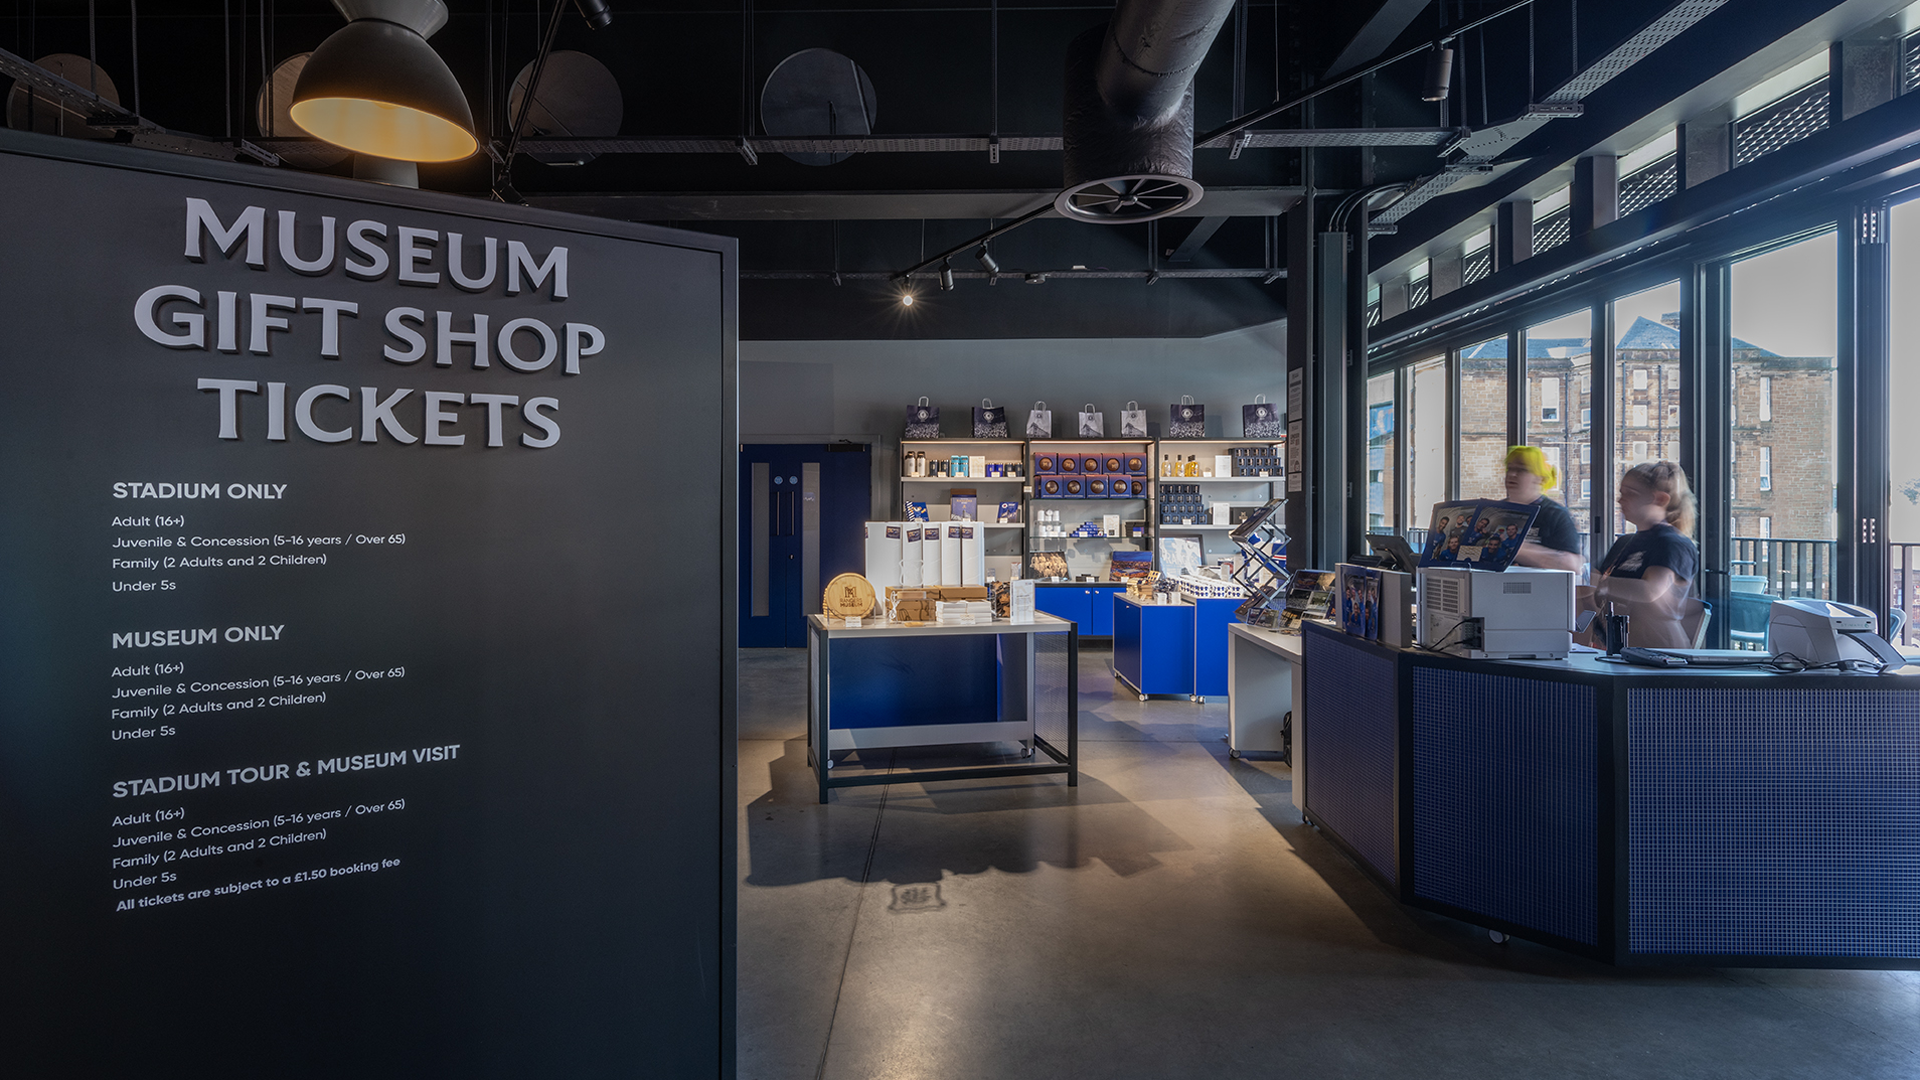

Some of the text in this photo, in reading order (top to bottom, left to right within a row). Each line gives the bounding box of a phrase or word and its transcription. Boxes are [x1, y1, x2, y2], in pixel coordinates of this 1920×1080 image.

[184, 197, 568, 300] MUSEUM
[134, 284, 606, 375] GIFT SHOP
[197, 377, 562, 449] TICKETS
[112, 481, 288, 500] STADIUM ONLY
[111, 514, 185, 528] Adult (16+)
[111, 532, 406, 549] Juvenile & Concession (5-16 years / Over 65)
[112, 553, 327, 571] Family (2 Adults and 2 Children)
[112, 579, 177, 593] Under 5s
[112, 624, 285, 650] MUSEUM ONLY
[110, 661, 185, 678] Adult (16+)
[111, 665, 406, 699] Juvenile & Concession (5-16 years / Over 65)
[111, 690, 327, 720] Family (2 Adults and 2 Children)
[111, 725, 176, 741] Under 5s
[112, 743, 461, 799] STADIUM TOUR & MUSEUM VISIT
[111, 806, 185, 827] Adult (16+)
[112, 797, 406, 848] Juvenile & Concession (5-16 years / Over 65)
[112, 827, 327, 870] Family (2 Adults and 2 Children)
[112, 871, 177, 890] Under 5s
[115, 858, 401, 912] All tickets are subject to a £1.50 booking fee
